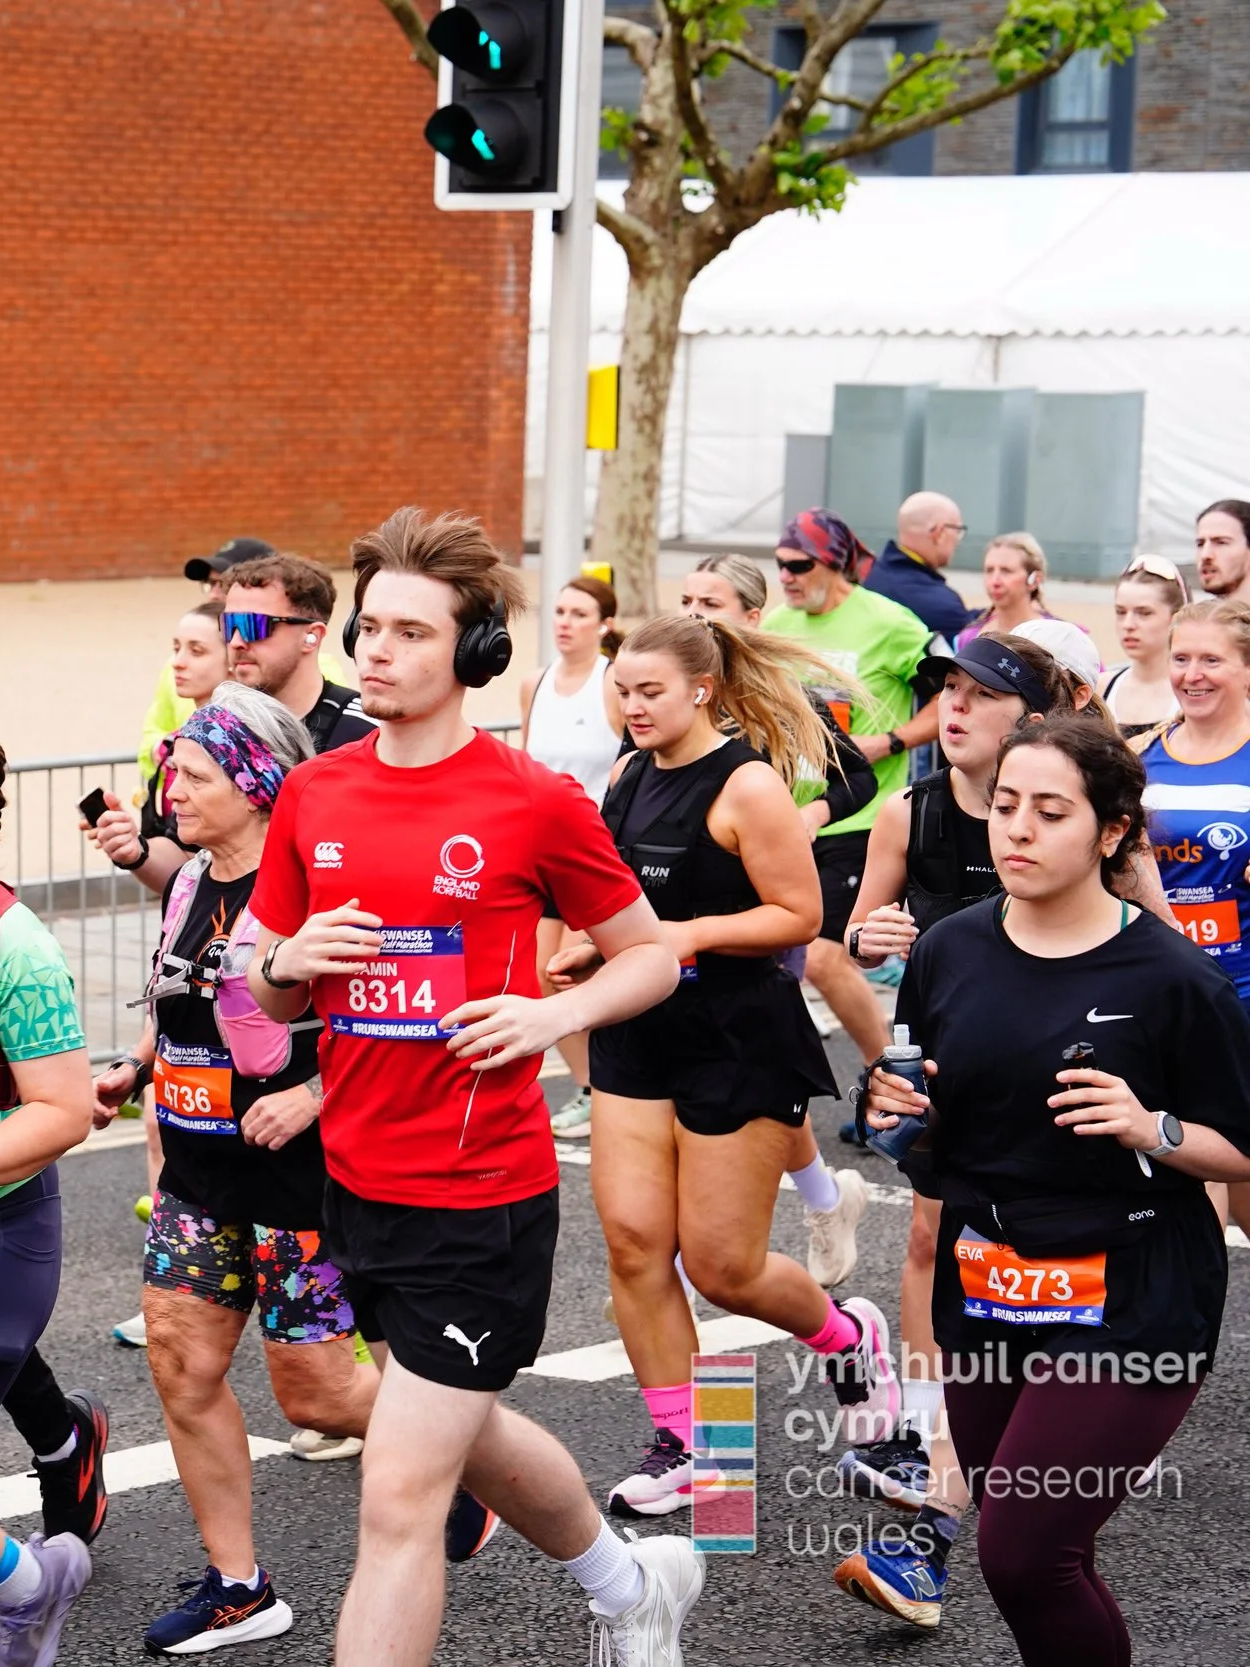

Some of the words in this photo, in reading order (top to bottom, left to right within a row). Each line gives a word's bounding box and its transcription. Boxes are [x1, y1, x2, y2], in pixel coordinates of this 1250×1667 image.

[641, 865, 670, 877] RUN
[434, 875, 481, 892] ENGLAND
[432, 885, 479, 900] KORFBALL
[380, 929, 433, 941] SWANSEA
[396, 940, 434, 950] Marathon
[348, 978, 437, 1014] 8314
[352, 1022, 438, 1038] #RUNSWANSEA
[170, 1046, 210, 1057] SWANSEA
[164, 1079, 212, 1113] 4736
[1128, 1209, 1155, 1222] eono
[957, 1245, 986, 1262] EVA
[987, 1266, 1074, 1301] 4273
[992, 1307, 1072, 1323] #RUNSWANSEA
